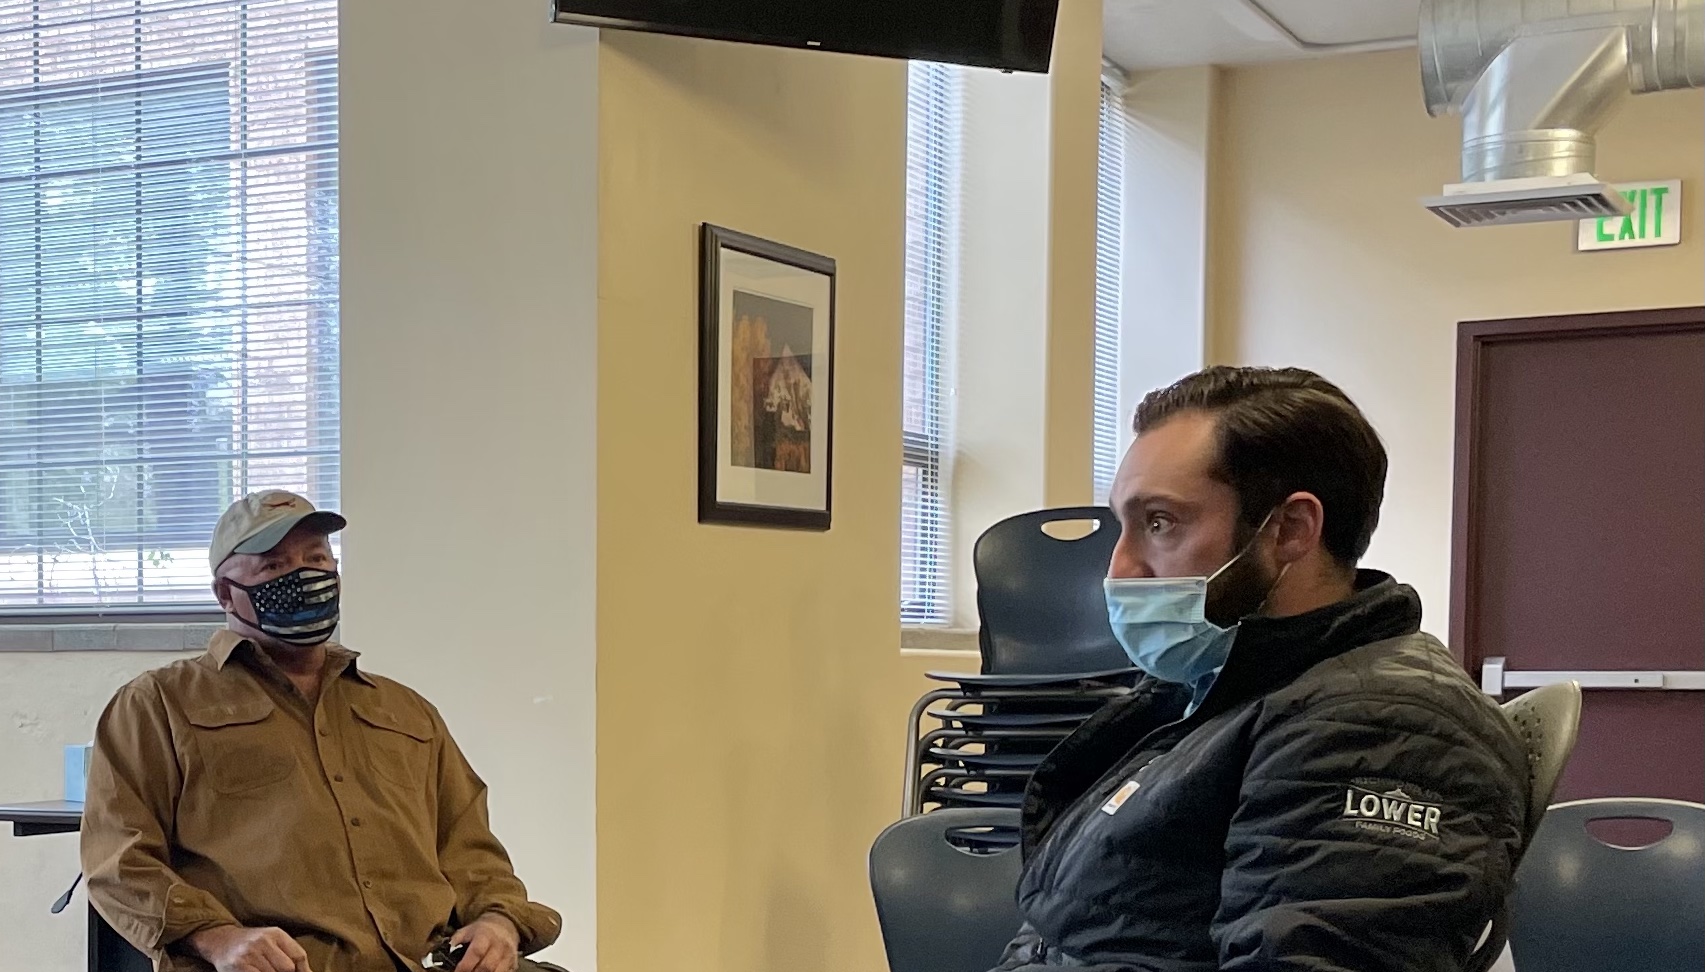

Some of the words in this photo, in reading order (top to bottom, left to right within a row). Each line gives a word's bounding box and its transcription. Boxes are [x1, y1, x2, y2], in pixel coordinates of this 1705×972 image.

[1343, 789, 1442, 834] LOWER
[1355, 820, 1391, 833] FAMILY
[1392, 827, 1426, 841] FOODS
